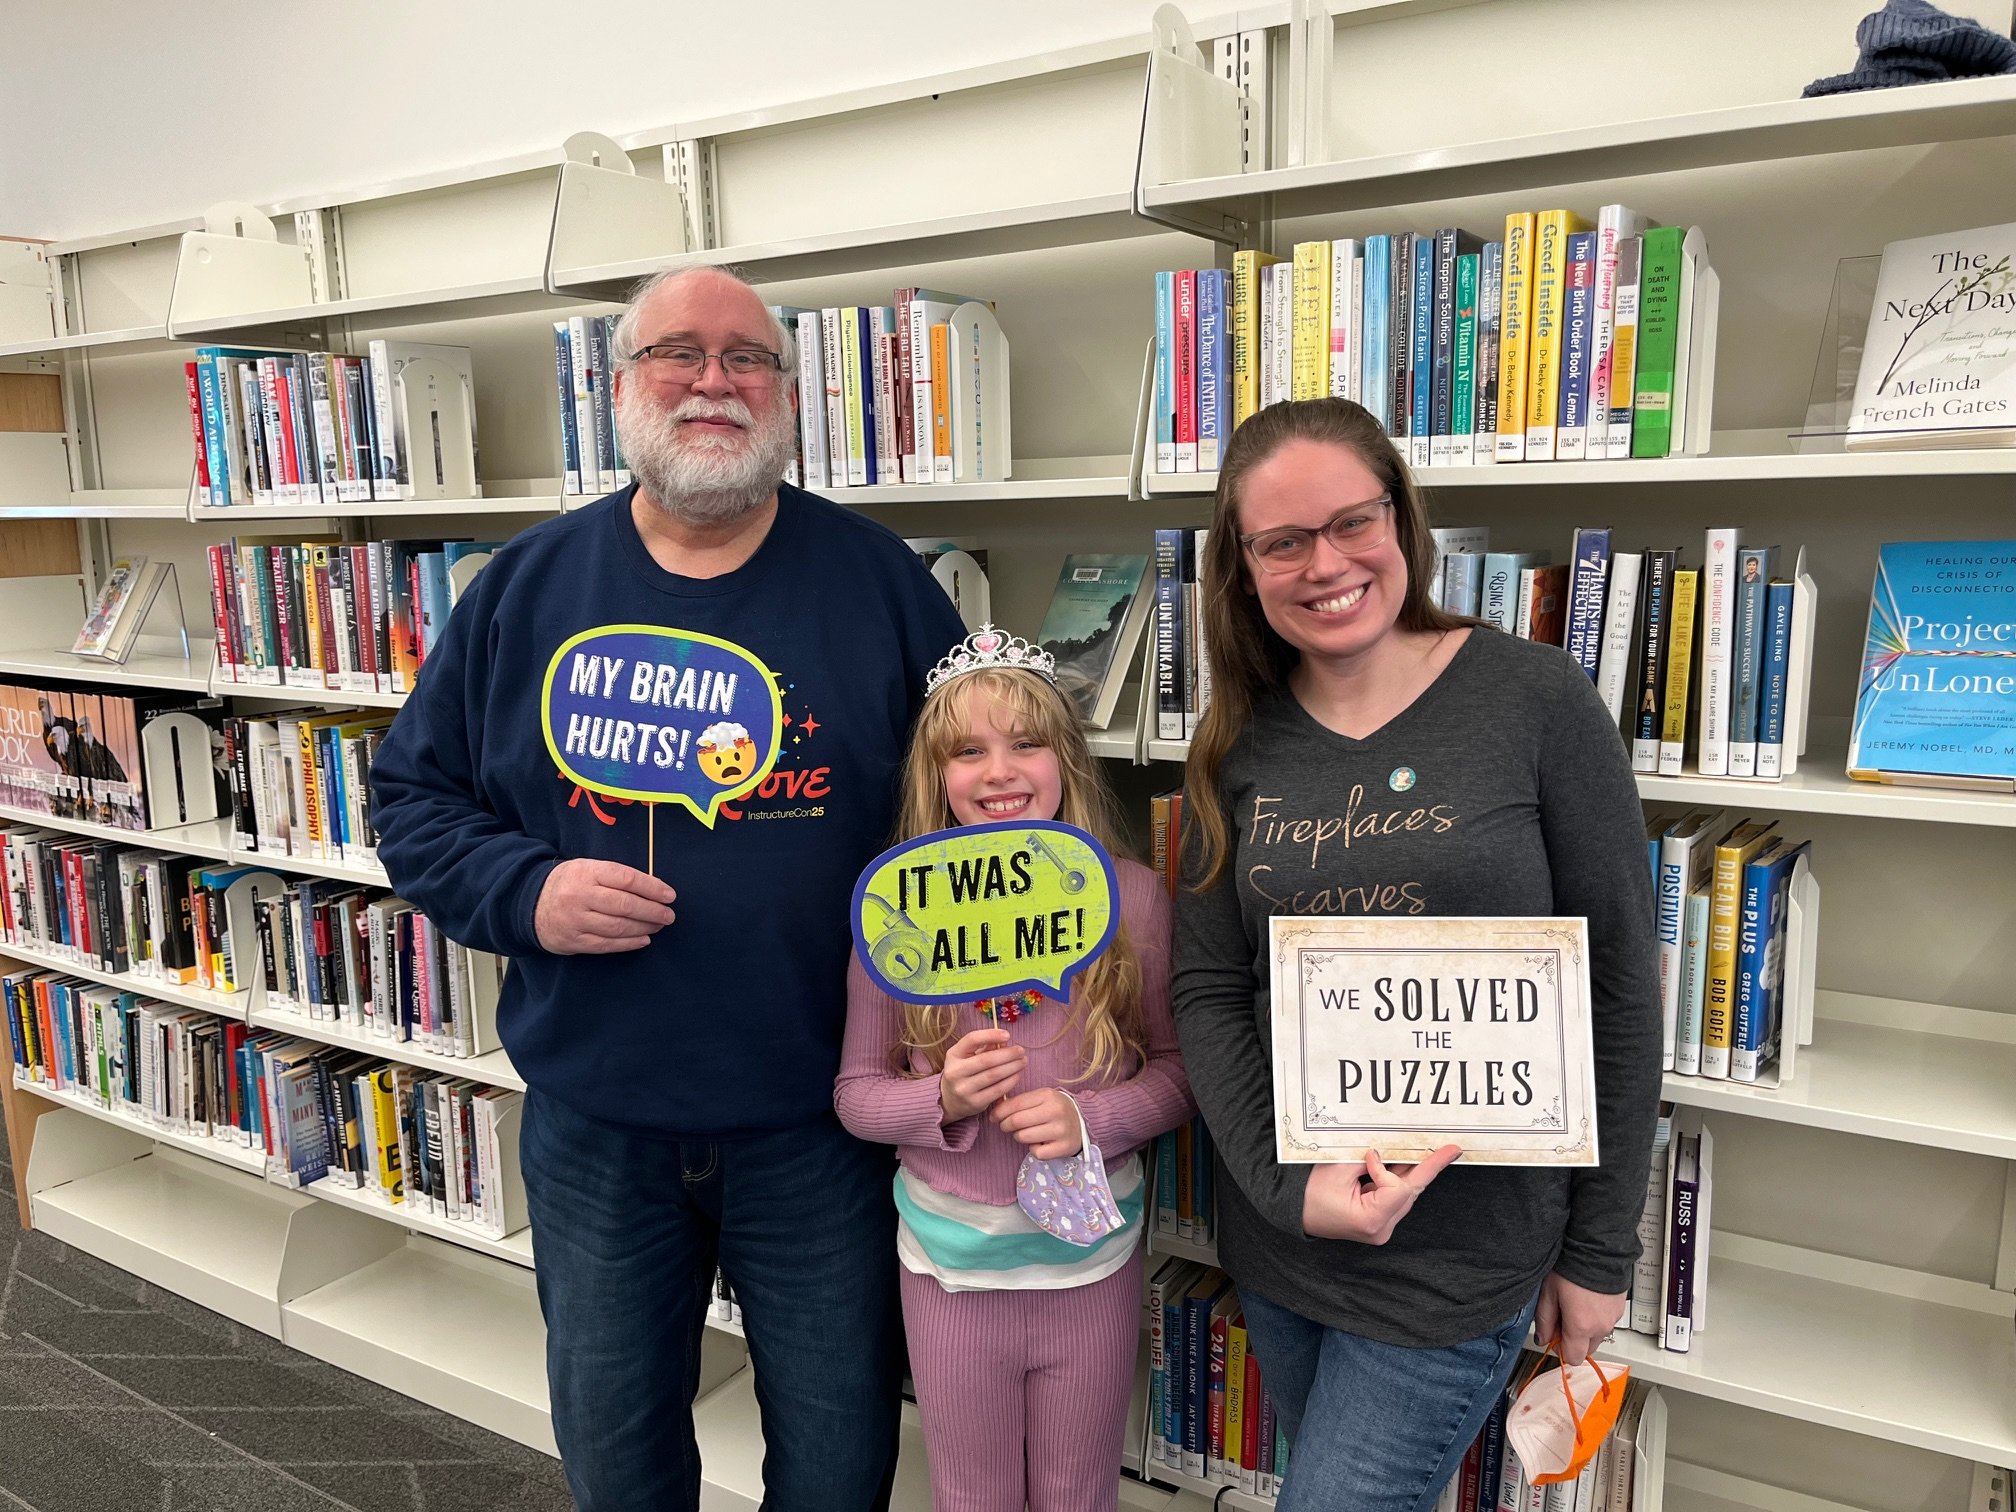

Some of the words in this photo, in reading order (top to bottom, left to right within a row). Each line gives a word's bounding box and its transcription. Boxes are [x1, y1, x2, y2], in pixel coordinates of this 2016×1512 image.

[1442, 234, 1453, 254] The
[1510, 227, 1525, 275] Good
[1541, 224, 1557, 273] Good
[1575, 240, 1589, 260] The
[1439, 257, 1452, 300] Tapping
[1574, 262, 1587, 287] New
[1654, 265, 1664, 273] ON
[1932, 251, 1988, 274] The
[1235, 258, 1247, 308] FAILURE
[1278, 269, 1287, 294] From
[1647, 275, 1670, 283] DEATH
[1651, 285, 1665, 293] AND
[1180, 279, 1192, 318] under
[1417, 271, 1429, 335] Stress-Proof
[1506, 281, 1523, 339] Inside
[1537, 279, 1556, 337] Inside
[1572, 290, 1585, 316] Birth
[1883, 298, 1955, 321] Next
[1201, 315, 1216, 334] The
[1235, 310, 1247, 326] TO
[1276, 296, 1287, 336] Strength
[1438, 302, 1450, 346] Solution
[845, 320, 853, 353] Physical
[900, 325, 909, 351] HEAD
[913, 311, 924, 376] Remember
[1178, 322, 1192, 376] pressure
[1277, 338, 1287, 347] to
[1417, 336, 1427, 362] Brain
[1458, 321, 1472, 367] Vitamin
[1570, 319, 1584, 348] Order
[1599, 320, 1610, 370] THERESA
[574, 330, 584, 387] PERMISSION
[1201, 334, 1215, 366] Dance
[1235, 328, 1247, 373] LAUNCH
[1397, 331, 1407, 371] COLLIDE
[1568, 352, 1583, 379] Book
[901, 356, 910, 379] TRIP
[1201, 368, 1216, 380] of
[1275, 350, 1287, 389] Strength
[1505, 364, 1516, 388] Becky
[1536, 363, 1548, 387] Becky
[203, 377, 217, 425] WORLD
[219, 372, 231, 426] DINOSAURS
[916, 389, 924, 410] LISA
[1396, 376, 1405, 400] JOHN
[1439, 378, 1447, 400] NICK
[1596, 376, 1606, 422] CAPUTO
[1893, 375, 1981, 398] Melinda
[1201, 380, 1217, 437] INTIMACY
[1488, 401, 1497, 432] FENTON
[1503, 389, 1515, 422] Kennedy
[1535, 389, 1547, 421] Kennedy
[1565, 392, 1580, 427] Leman
[1863, 400, 1936, 423] French
[1943, 398, 2007, 416] Gates
[917, 412, 925, 448] GENOVA
[1579, 559, 1608, 573] 7
[1653, 558, 1663, 585] THERE'S
[1713, 563, 1724, 577] THE
[1925, 557, 1984, 566] HEALING
[1937, 571, 1980, 580] CRISIS
[1986, 571, 2003, 579] OF
[272, 555, 287, 625] TRAILBLAZER
[1162, 587, 1170, 600] THE
[1489, 572, 1508, 607] RISING
[1572, 571, 1590, 630] EFFECTIVE
[1587, 571, 1607, 619] HABITS
[1712, 579, 1723, 625] CONFIDENCE
[371, 589, 382, 631] MADDOW
[1651, 599, 1661, 616] PLAN
[1744, 598, 1754, 637] PATHWAY
[1775, 605, 1785, 635] GAYLE
[306, 584, 315, 624] LAWSON
[311, 630, 320, 669] BROKEN
[1610, 632, 1628, 640] Good
[1650, 624, 1658, 637] FOR
[1711, 626, 1721, 647] CODE
[1158, 602, 1173, 693] UNTHINKABLE
[1583, 630, 1599, 671] HIGHLY
[1648, 639, 1657, 657] YOUR
[1774, 639, 1783, 662] KING
[1741, 647, 1752, 682] SUCCESS
[1871, 665, 2016, 696] UnLone
[569, 653, 625, 699] MY
[629, 661, 738, 715] BRAIN
[1670, 662, 1685, 703] MUSICAL
[1771, 674, 1781, 700] NOTE
[144, 709, 158, 720] 22
[1770, 703, 1779, 714] TO
[565, 713, 692, 771] HURTS!
[1768, 718, 1778, 741] SELF
[1867, 741, 1915, 750] JEREMY
[1920, 743, 1967, 753] NOBEL,
[1973, 745, 1998, 755] MD,
[748, 806, 825, 820] InstructureCon25
[1248, 783, 1460, 869] Fireplaces
[1156, 825, 1166, 852] WHOLE
[1156, 853, 1166, 871] NEW
[899, 865, 936, 911] IT
[948, 850, 1034, 904] WAS
[1248, 864, 1432, 916] Scarves
[1715, 860, 1737, 916] DREAM
[1660, 864, 1681, 946] POSITIVITY
[1748, 888, 1757, 907] THE
[931, 922, 1001, 972] ALL
[1015, 908, 1085, 961] ME!
[1713, 924, 1732, 952] BIG
[1742, 910, 1759, 954] PLUS
[414, 925, 424, 952] SYLVIA
[419, 996, 430, 1033] INSIGHT
[1711, 978, 1726, 1004] BOB
[1741, 972, 1751, 1001] GREG
[411, 990, 420, 1015] Quest
[1319, 989, 1360, 1010] WE
[1373, 977, 1539, 1023] SOLVED
[96, 1023, 105, 1055] HTML5
[1412, 1031, 1452, 1049] THE
[1708, 1010, 1725, 1041] GOFF
[1737, 1005, 1750, 1050] GUTFELD
[1338, 1059, 1534, 1106] PUZZLES
[292, 1103, 314, 1123] MANY
[335, 1089, 346, 1144] APPARITIONISTS
[425, 1109, 443, 1161] FREUD
[411, 1152, 421, 1185] JUNG
[1679, 1190, 1692, 1226] RUSS
[1151, 1289, 1161, 1324] LOVE
[1151, 1339, 1162, 1366] LIFE
[1210, 1331, 1224, 1374] 24/6
[1232, 1340, 1241, 1361] YOU
[1189, 1367, 1197, 1394] MONK
[1230, 1386, 1239, 1424] BADASS
[1188, 1421, 1196, 1453] SHETTY
